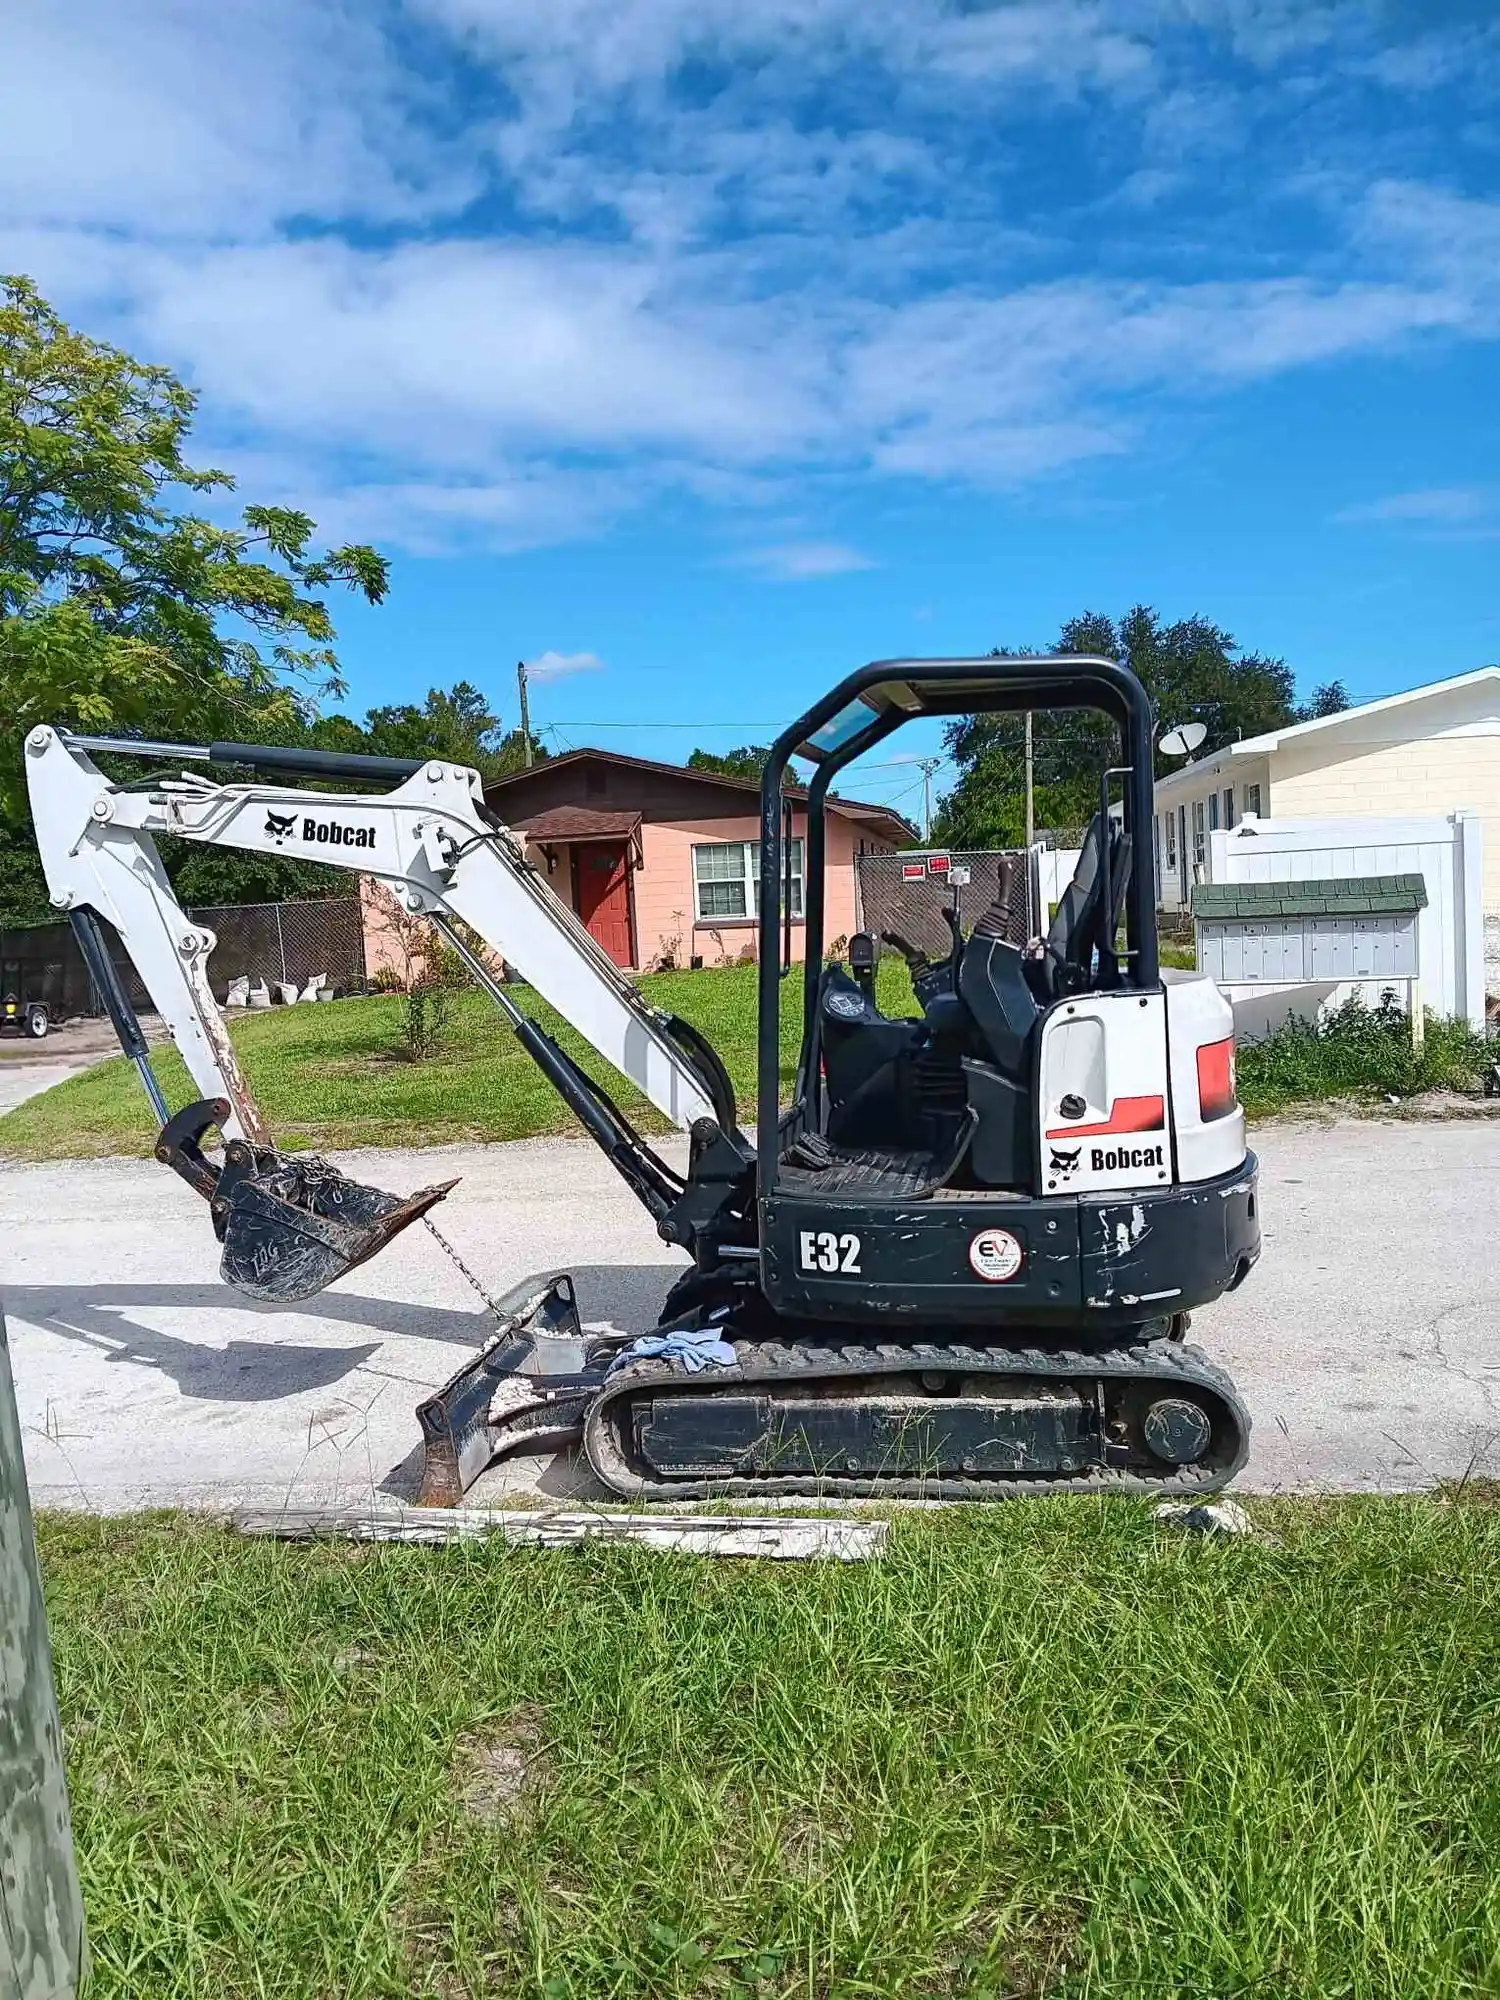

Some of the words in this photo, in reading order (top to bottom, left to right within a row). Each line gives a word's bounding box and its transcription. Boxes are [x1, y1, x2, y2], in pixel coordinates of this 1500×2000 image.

[302, 817, 377, 849] Bobcat
[1090, 1145, 1164, 1171] Bobcat
[799, 1231, 862, 1274] E32
[978, 1239, 1008, 1257] EV
